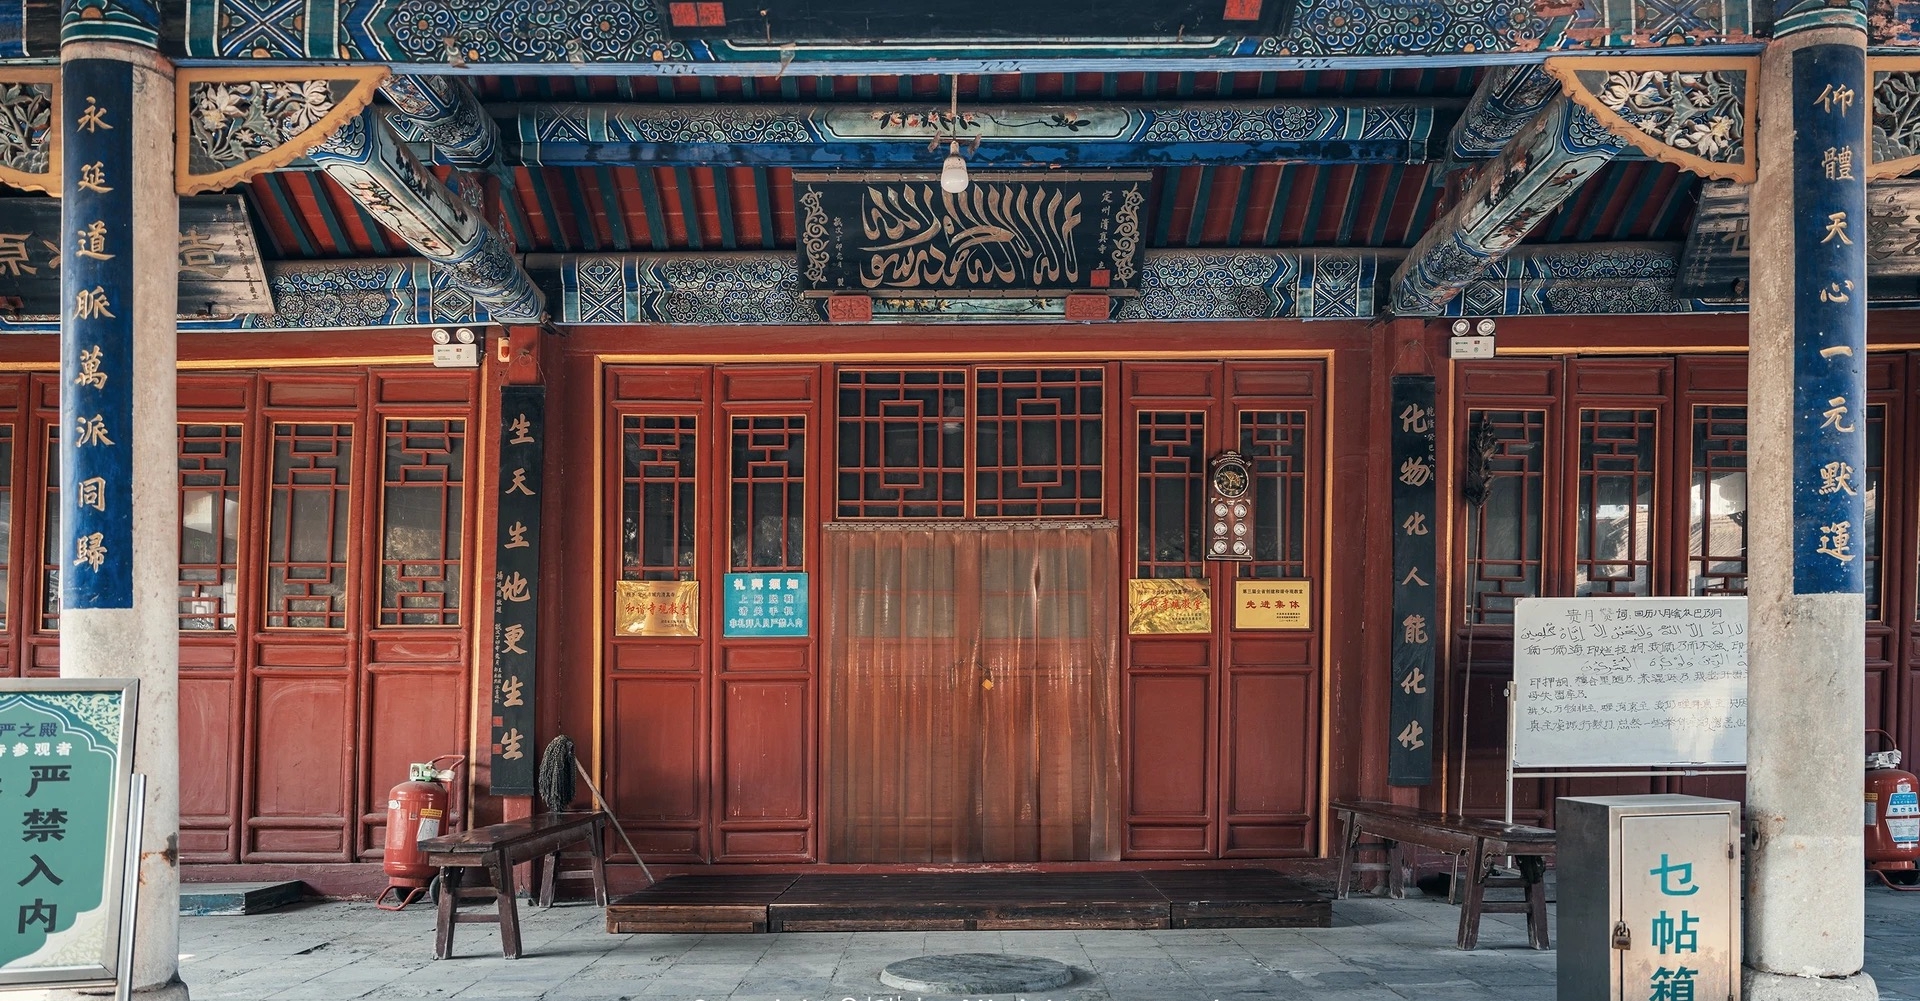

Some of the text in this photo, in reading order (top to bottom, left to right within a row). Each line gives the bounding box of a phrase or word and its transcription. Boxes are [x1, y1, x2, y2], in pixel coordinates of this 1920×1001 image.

[73, 96, 117, 573] 永延道脈萬派同歸
[1812, 83, 1857, 562] 仰體天心一元默運
[500, 413, 536, 760] 生天生地更生生
[733, 578, 799, 590] 礼拜须知
[738, 606, 795, 617] 请关手机
[1245, 599, 1300, 609] 先进集体
[1397, 403, 1430, 752] 化物化人能化化
[16, 764, 72, 935] 严禁入内
[1648, 853, 1700, 1001] 乜帖箱
